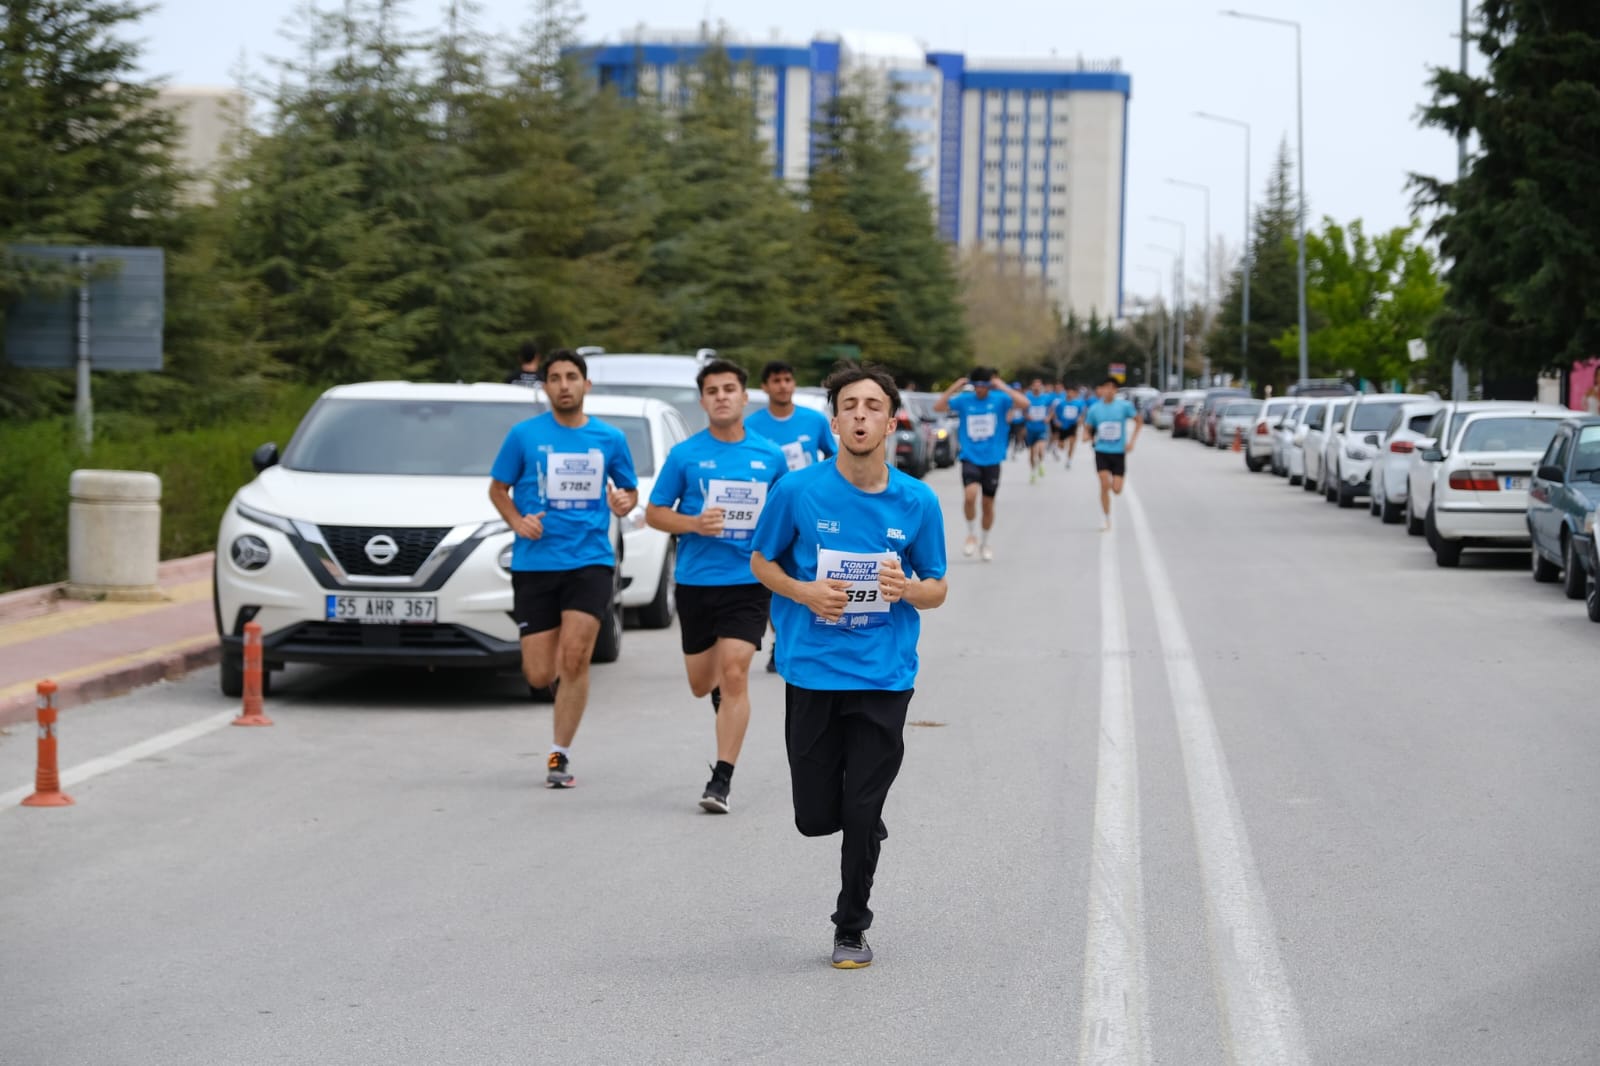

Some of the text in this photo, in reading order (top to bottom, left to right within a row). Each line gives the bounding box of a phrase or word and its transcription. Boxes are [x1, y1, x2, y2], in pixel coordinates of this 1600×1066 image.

[843, 561, 875, 569] KONYA
[338, 598, 433, 617] 55 AHR 367
